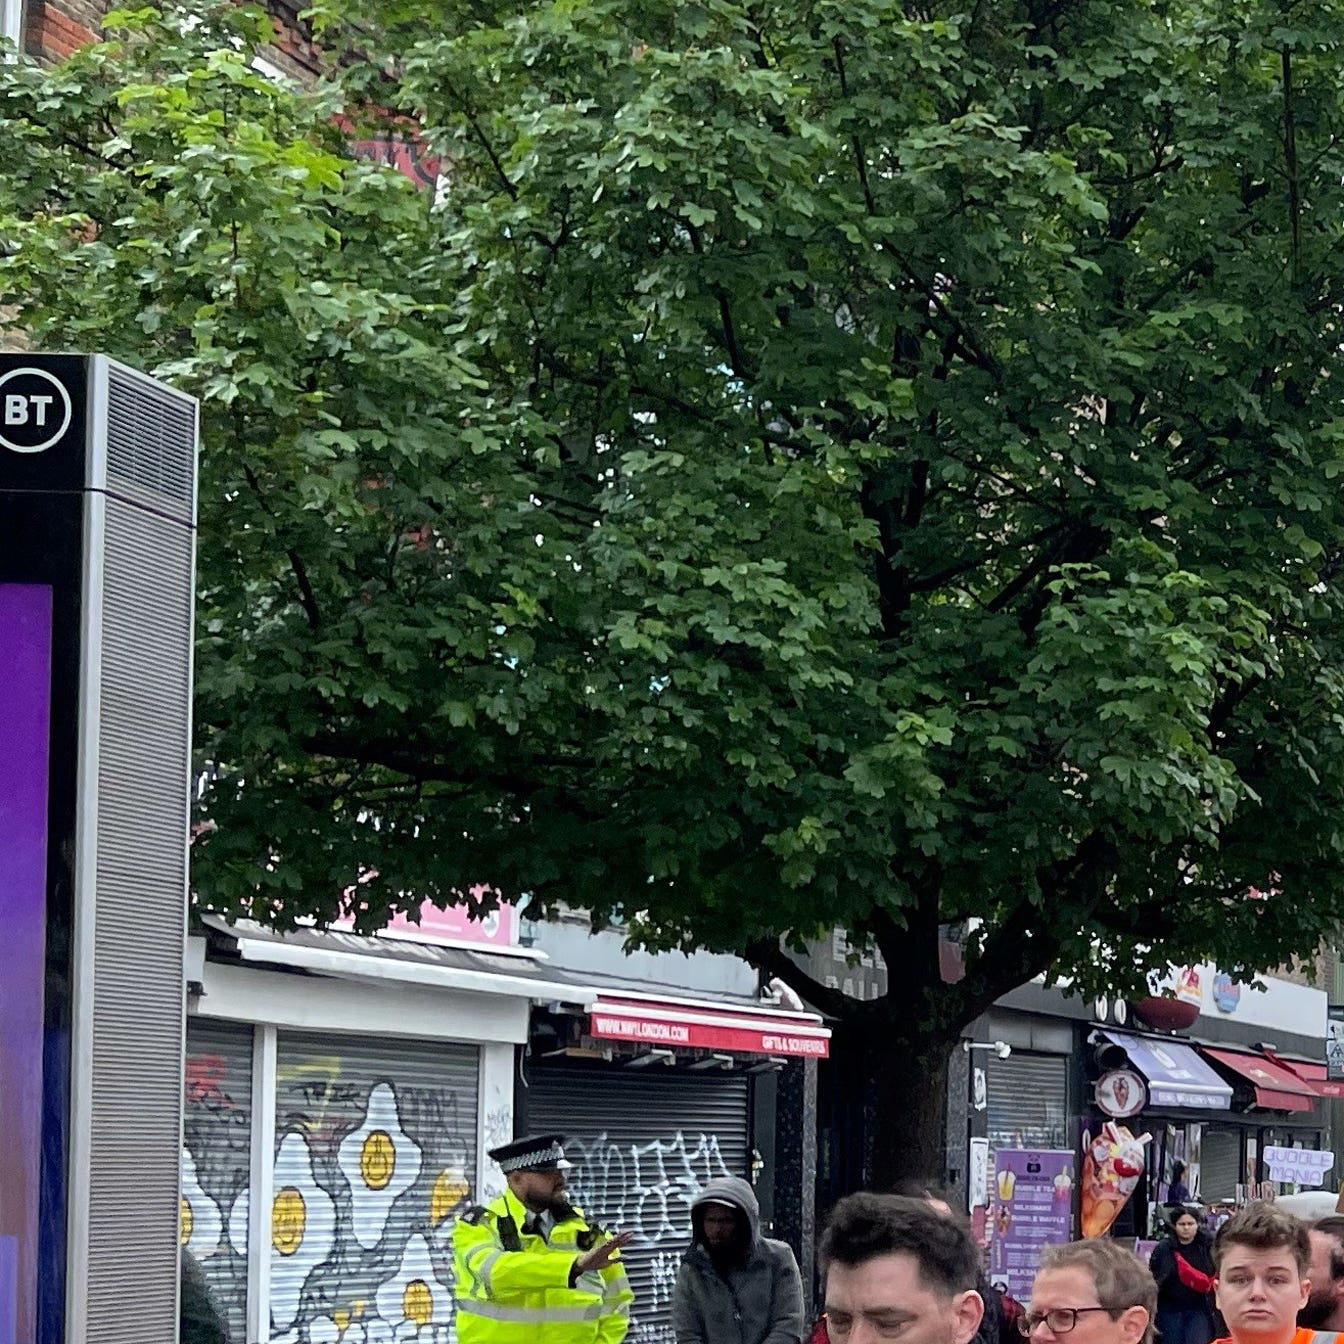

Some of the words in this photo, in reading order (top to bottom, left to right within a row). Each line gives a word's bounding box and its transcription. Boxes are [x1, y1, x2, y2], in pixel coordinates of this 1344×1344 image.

[5, 394, 53, 426] BT
[1264, 1147, 1332, 1168] BUBBLE
[1272, 1166, 1321, 1183] MANIA
